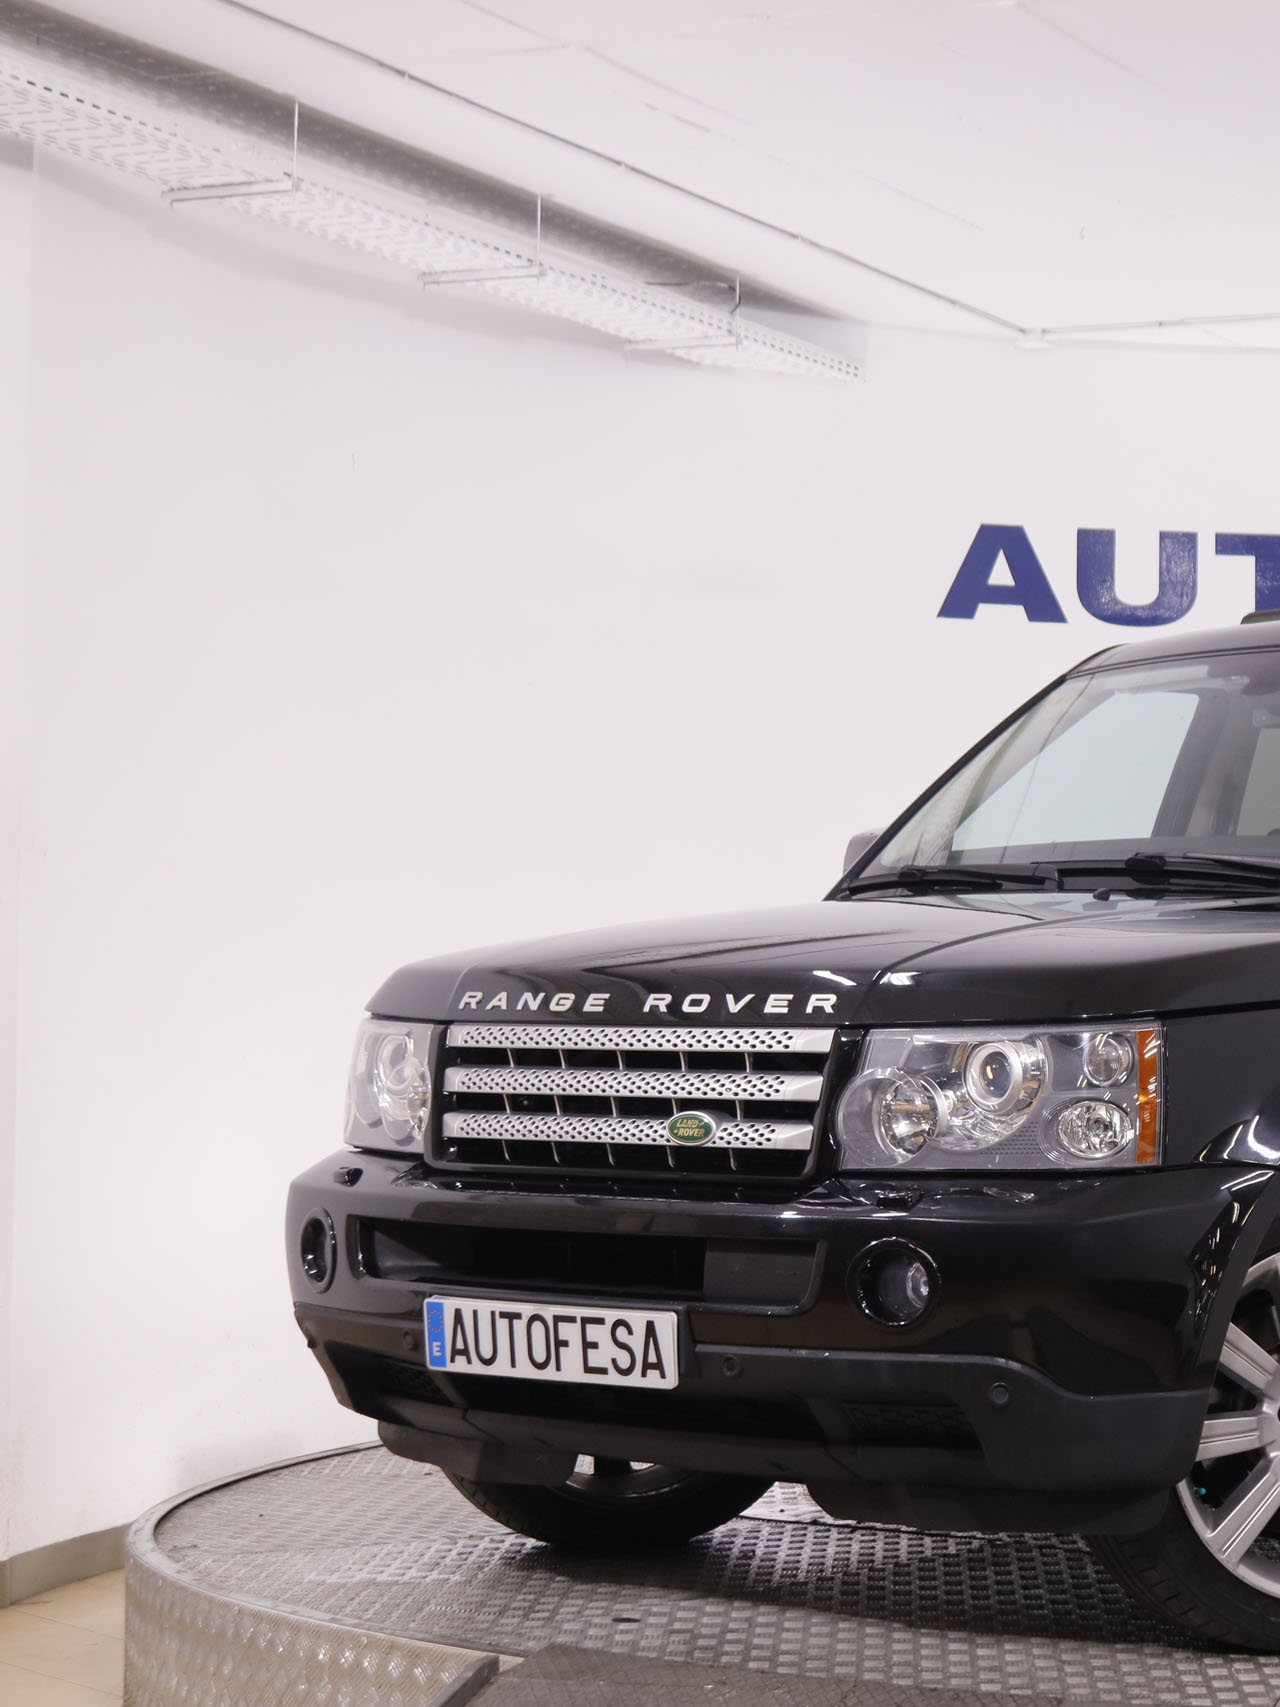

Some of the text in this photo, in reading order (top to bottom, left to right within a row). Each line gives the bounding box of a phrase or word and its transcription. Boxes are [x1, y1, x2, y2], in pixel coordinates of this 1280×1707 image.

[458, 991, 837, 1014] RANGE ROVER
[676, 1119, 699, 1128] LAND
[677, 1128, 705, 1137] ROVER
[433, 1341, 442, 1357] E
[450, 1308, 667, 1380] AUTOFESA
